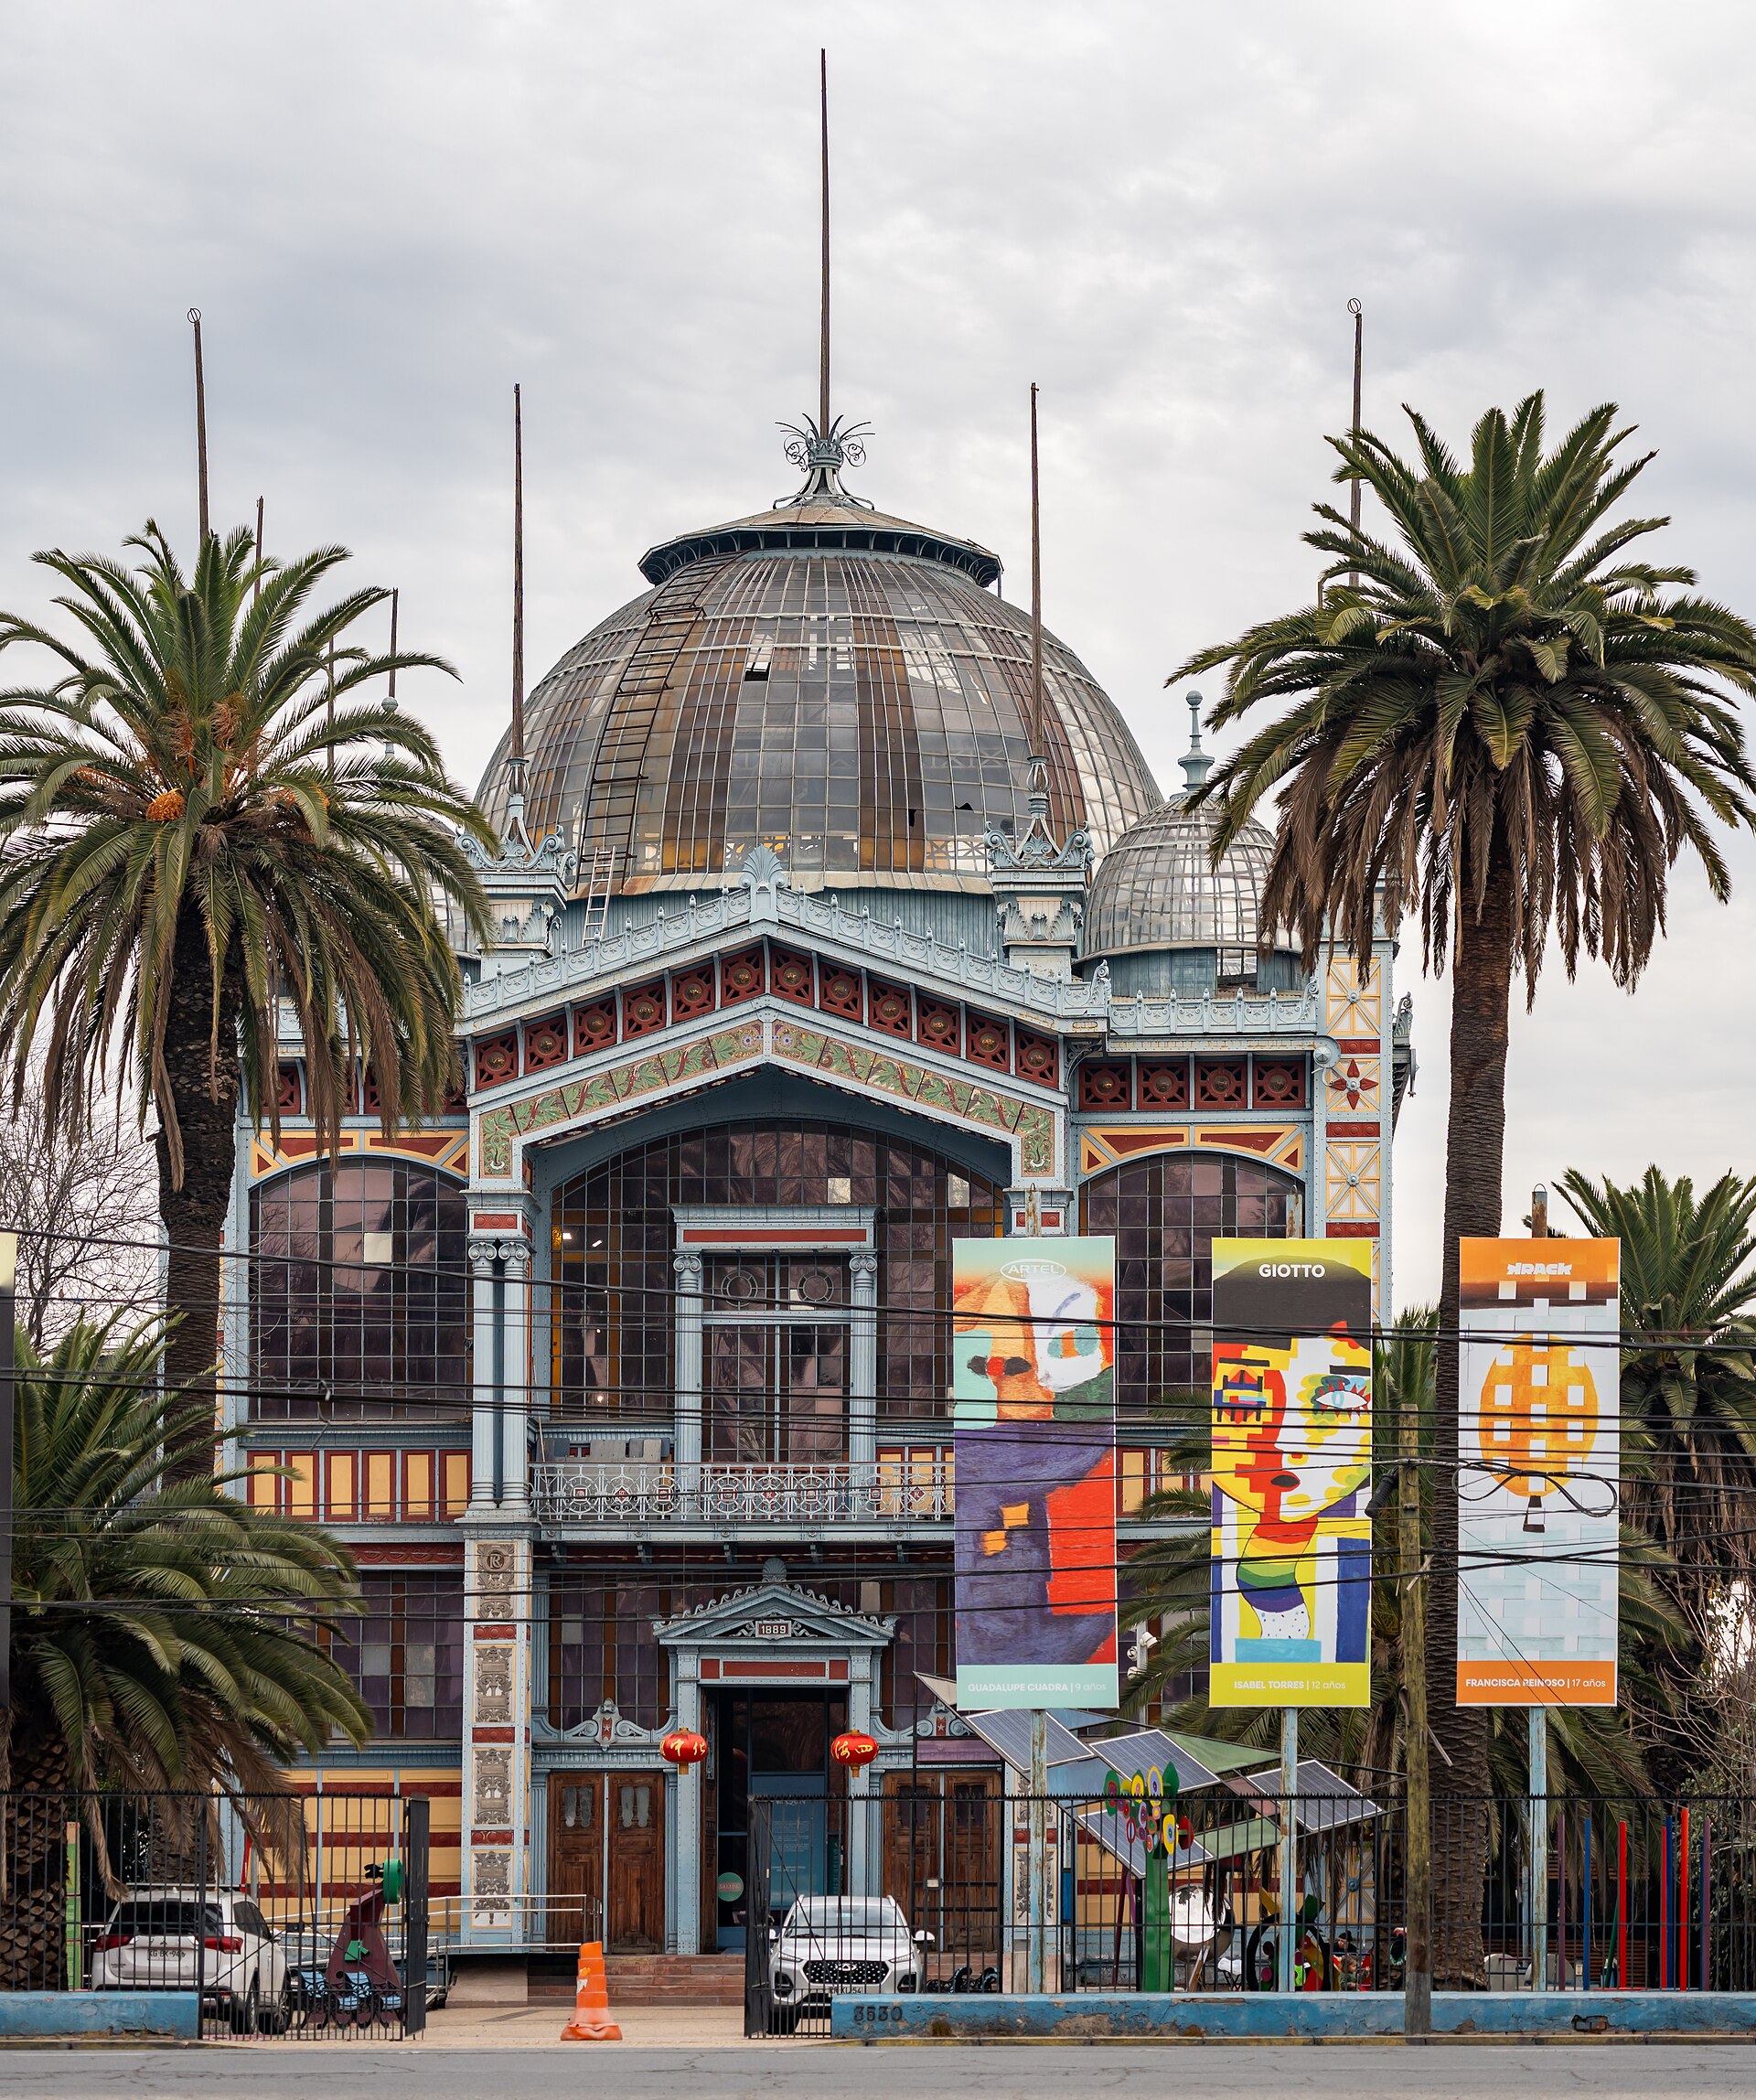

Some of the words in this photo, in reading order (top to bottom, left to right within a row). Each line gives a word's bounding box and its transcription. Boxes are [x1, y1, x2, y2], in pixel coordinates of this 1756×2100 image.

[1008, 1265, 1059, 1274] ARTEL
[1258, 1264, 1325, 1278] GIOTTO
[1507, 1262, 1572, 1275] KRACK
[761, 1625, 787, 1634] 1889
[968, 1683, 1025, 1692] GUADALUPE
[1027, 1683, 1069, 1692] CUADRA
[1075, 1683, 1081, 1691] 9
[1083, 1683, 1107, 1691] años
[1234, 1680, 1266, 1689] ISABEL
[1268, 1680, 1304, 1689] TORRES
[1312, 1680, 1321, 1689] 12
[1322, 1680, 1346, 1689] años
[1465, 1678, 1521, 1688] FRANCISCA
[1523, 1678, 1565, 1688] REINOSO
[1571, 1678, 1581, 1688] 17
[1582, 1678, 1606, 1688] años
[853, 2004, 903, 2021] 3530
